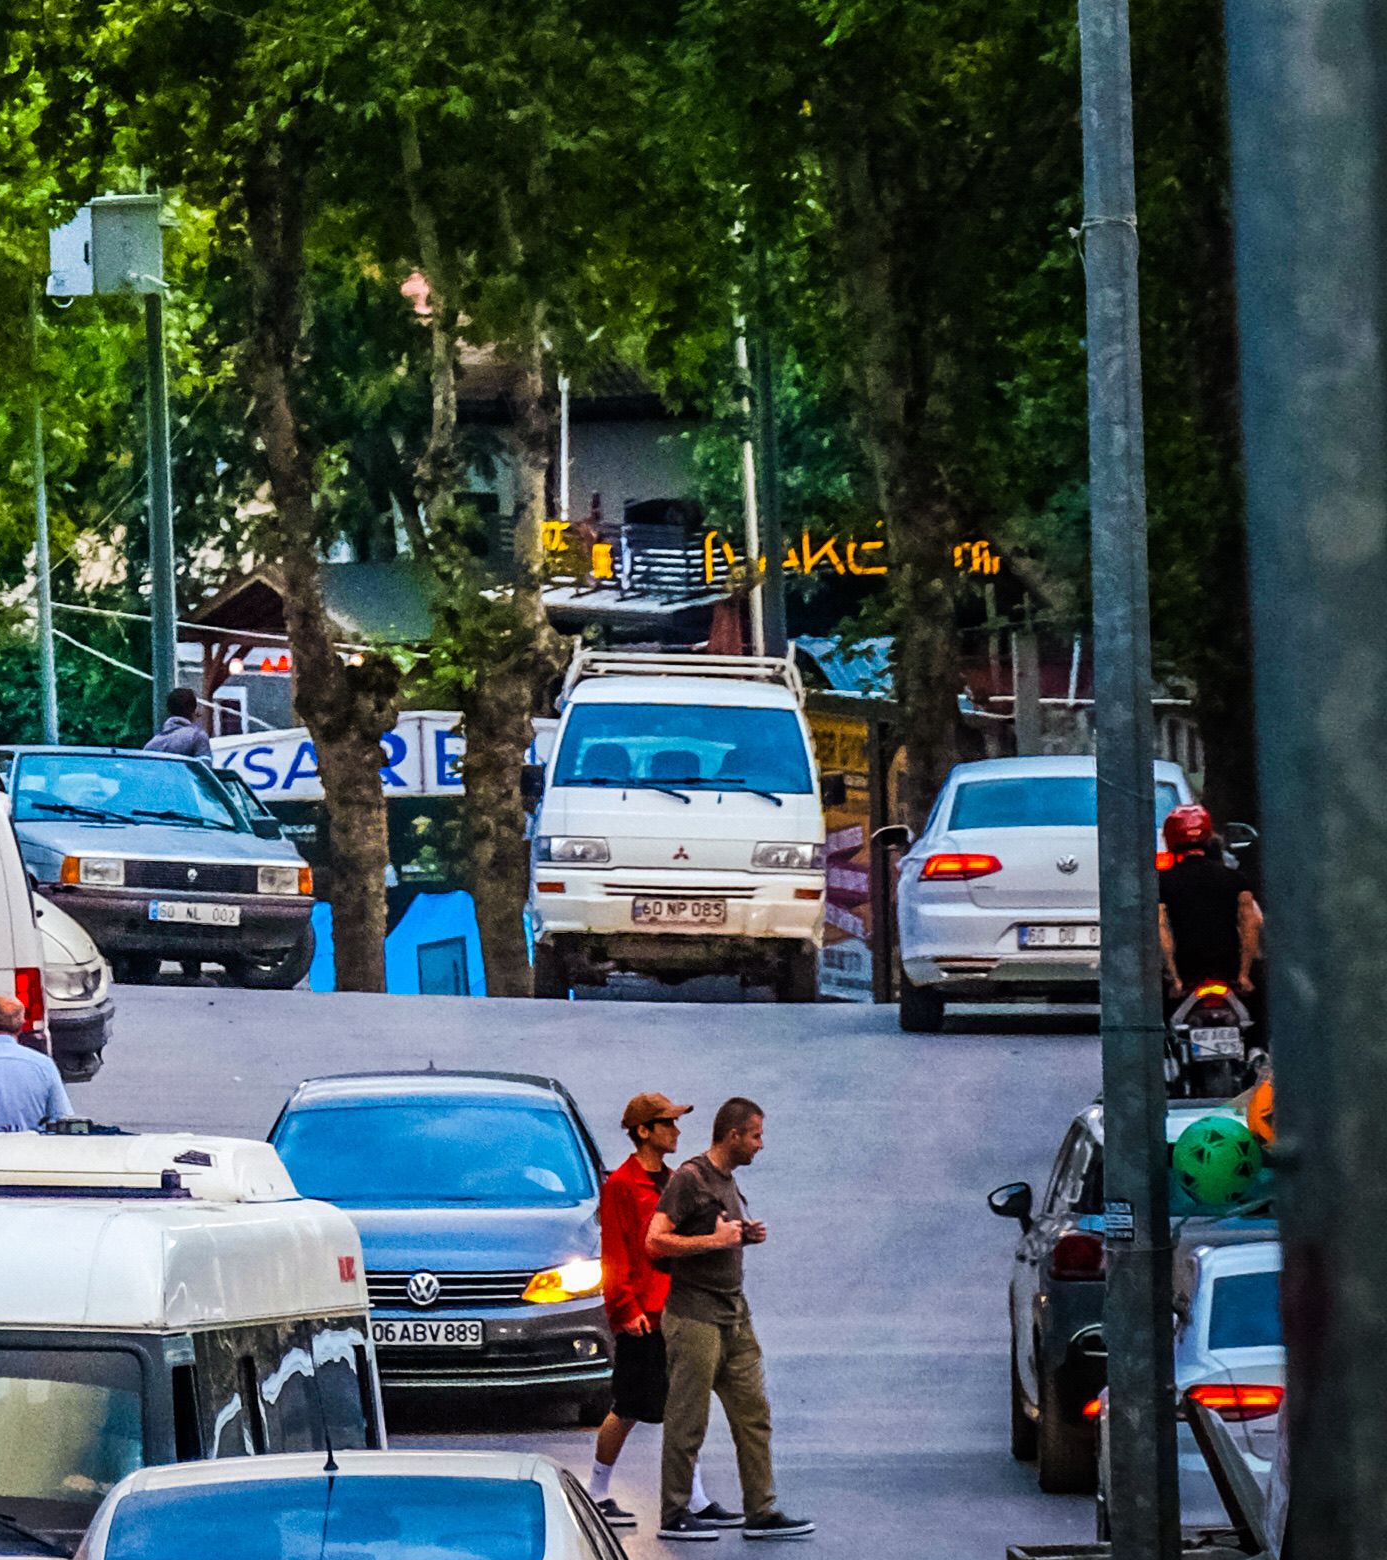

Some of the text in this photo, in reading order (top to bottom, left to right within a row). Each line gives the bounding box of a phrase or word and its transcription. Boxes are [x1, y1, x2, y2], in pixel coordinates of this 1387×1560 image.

[643, 901, 663, 916] 60
[372, 1323, 480, 1342] 06 ABV 889
